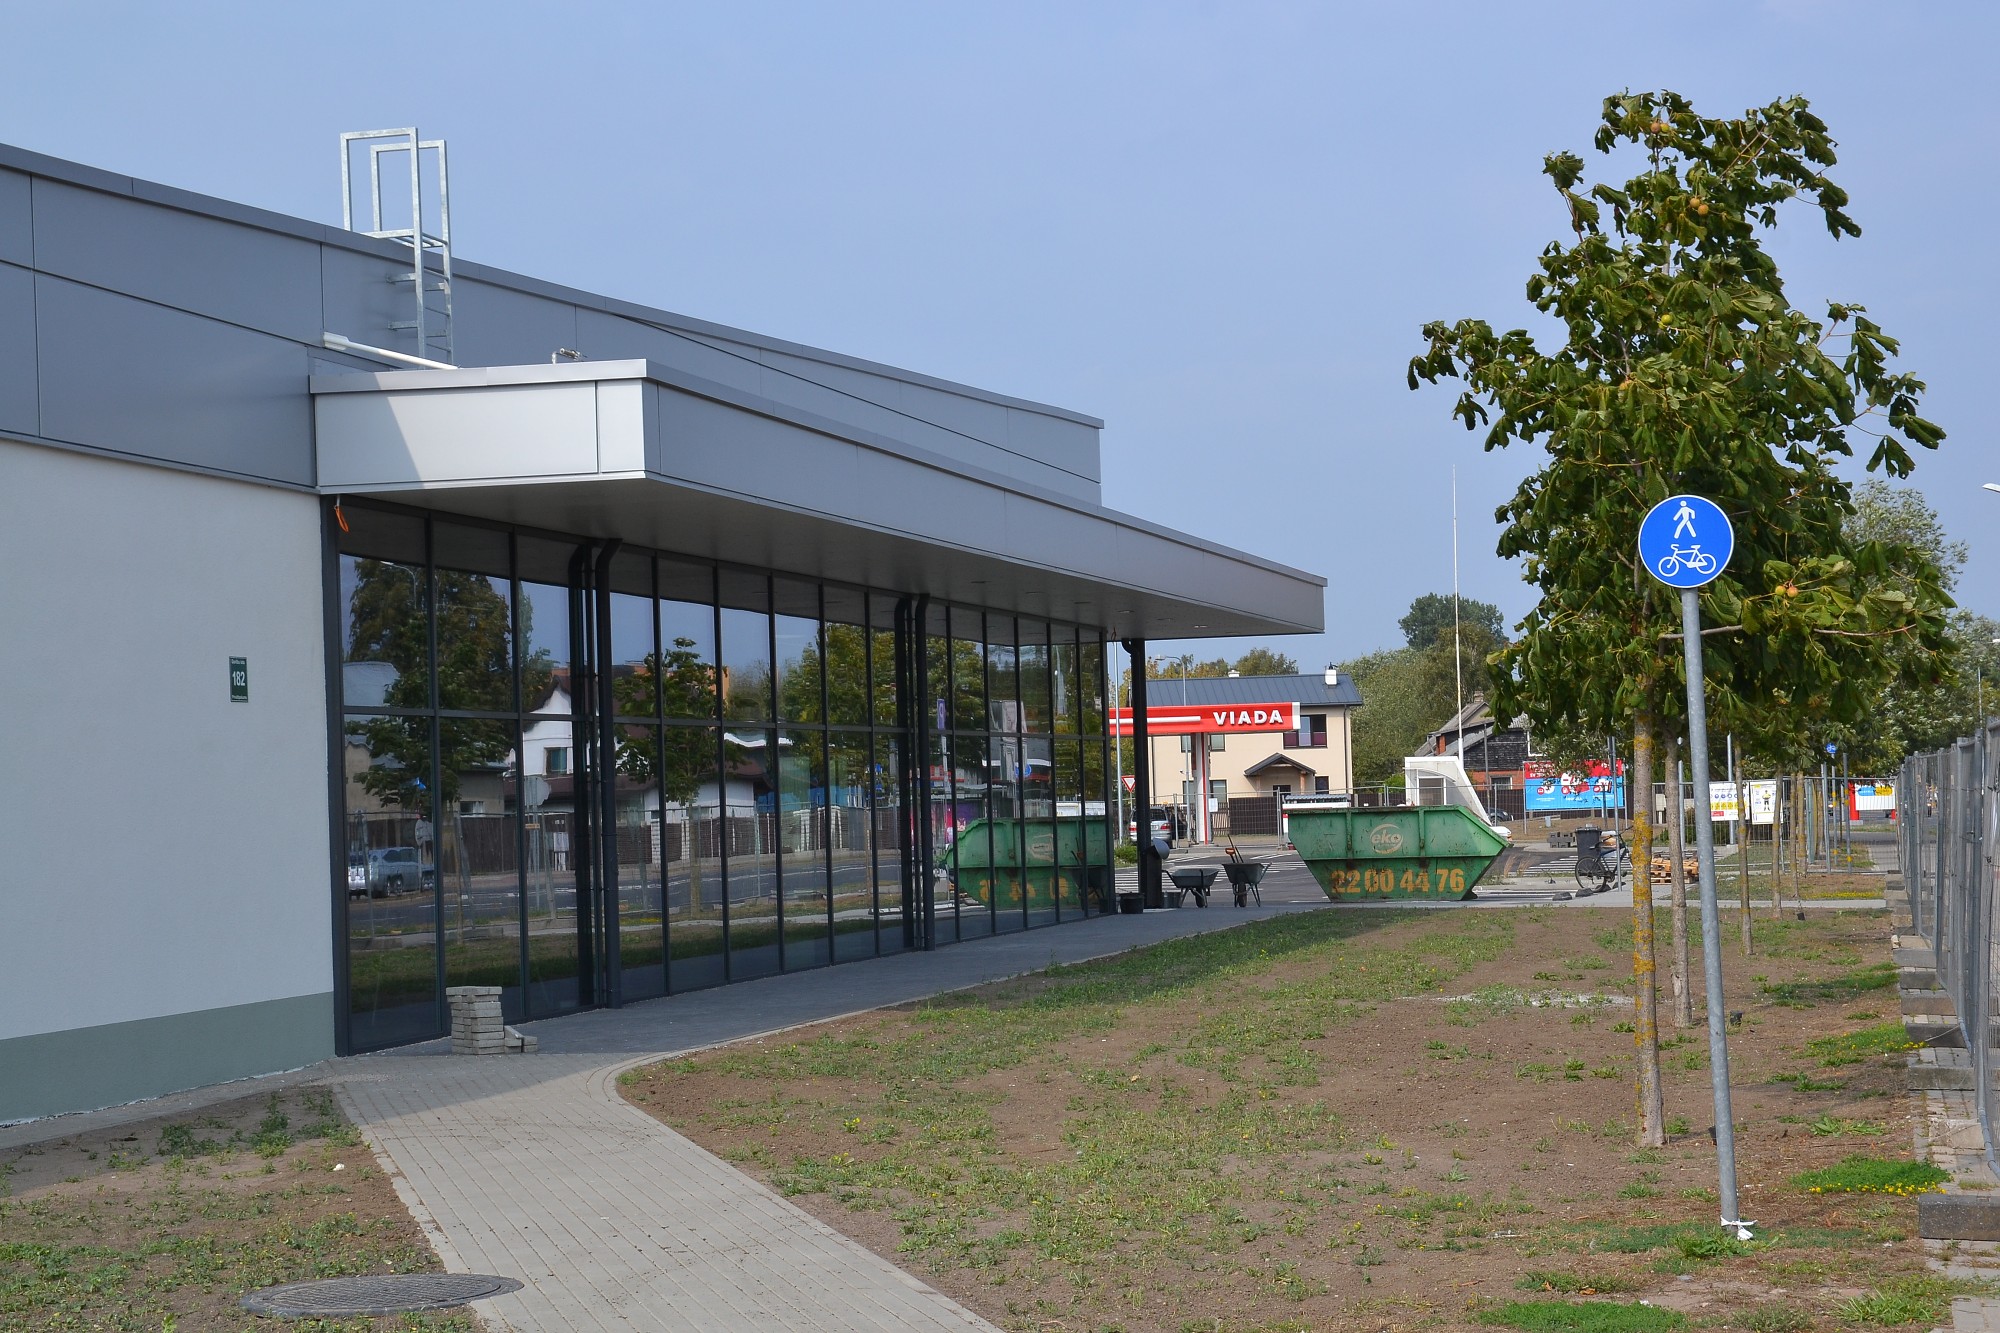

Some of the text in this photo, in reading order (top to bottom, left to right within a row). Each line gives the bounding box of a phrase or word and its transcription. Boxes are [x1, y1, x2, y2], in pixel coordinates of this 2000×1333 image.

[232, 671, 246, 686] 182
[1213, 709, 1284, 726] VIADA
[1371, 829, 1402, 844] eko
